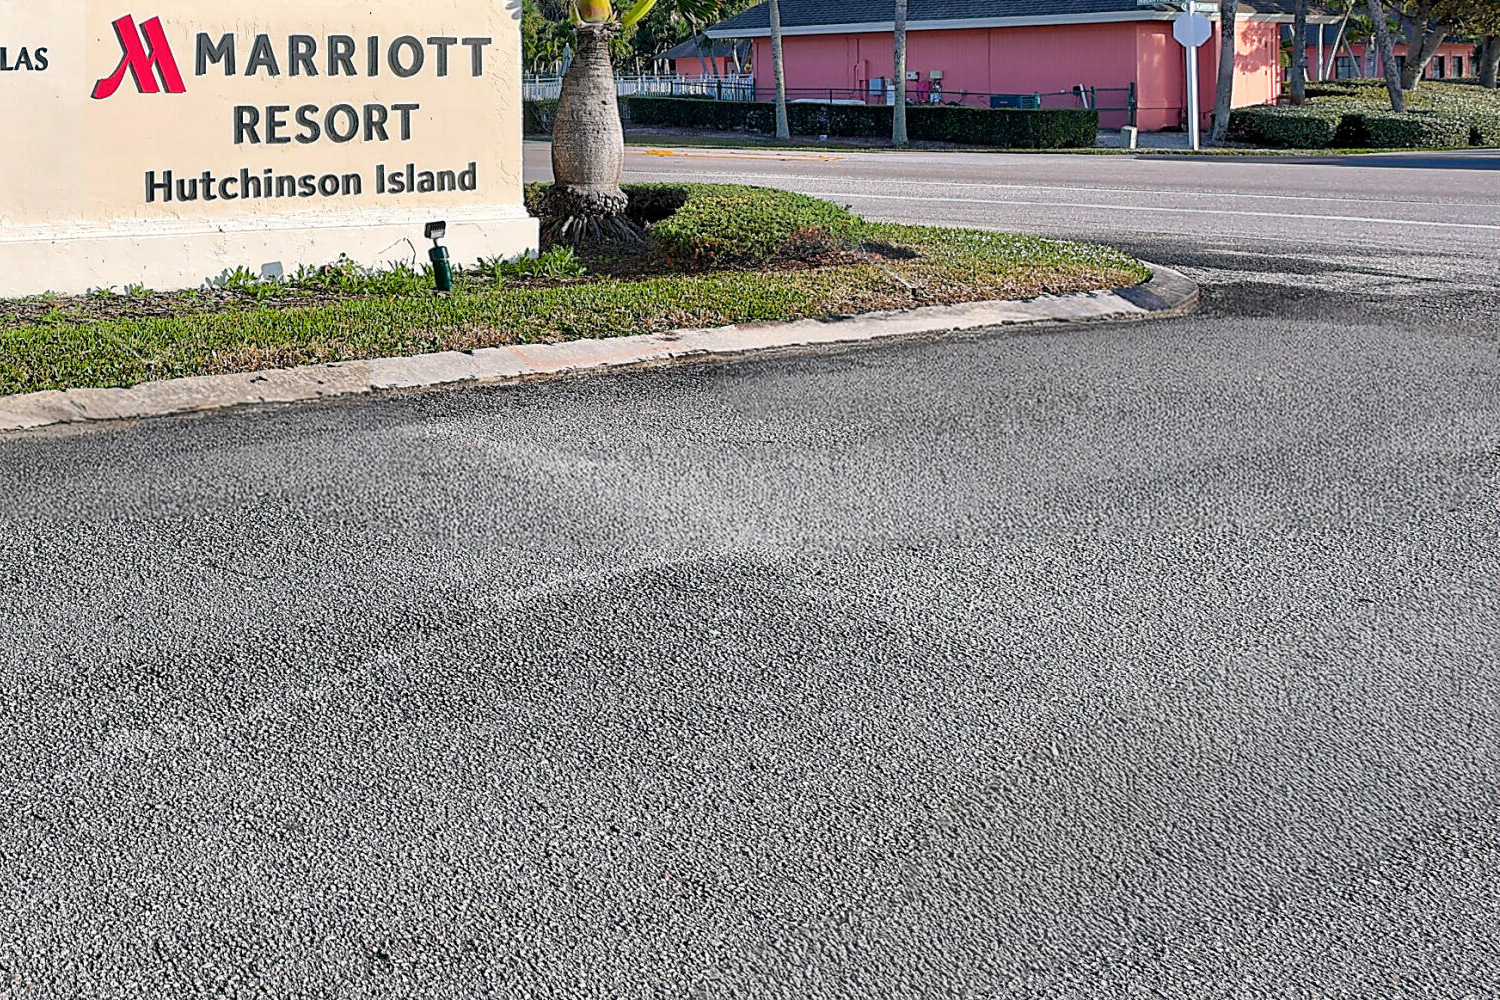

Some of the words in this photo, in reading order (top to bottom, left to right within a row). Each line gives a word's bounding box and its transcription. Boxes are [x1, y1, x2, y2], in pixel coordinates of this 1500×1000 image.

[196, 32, 492, 78] MARRIOTT
[233, 103, 420, 145] RESORT
[145, 167, 362, 203] Hutchinson
[375, 161, 477, 195] Island
